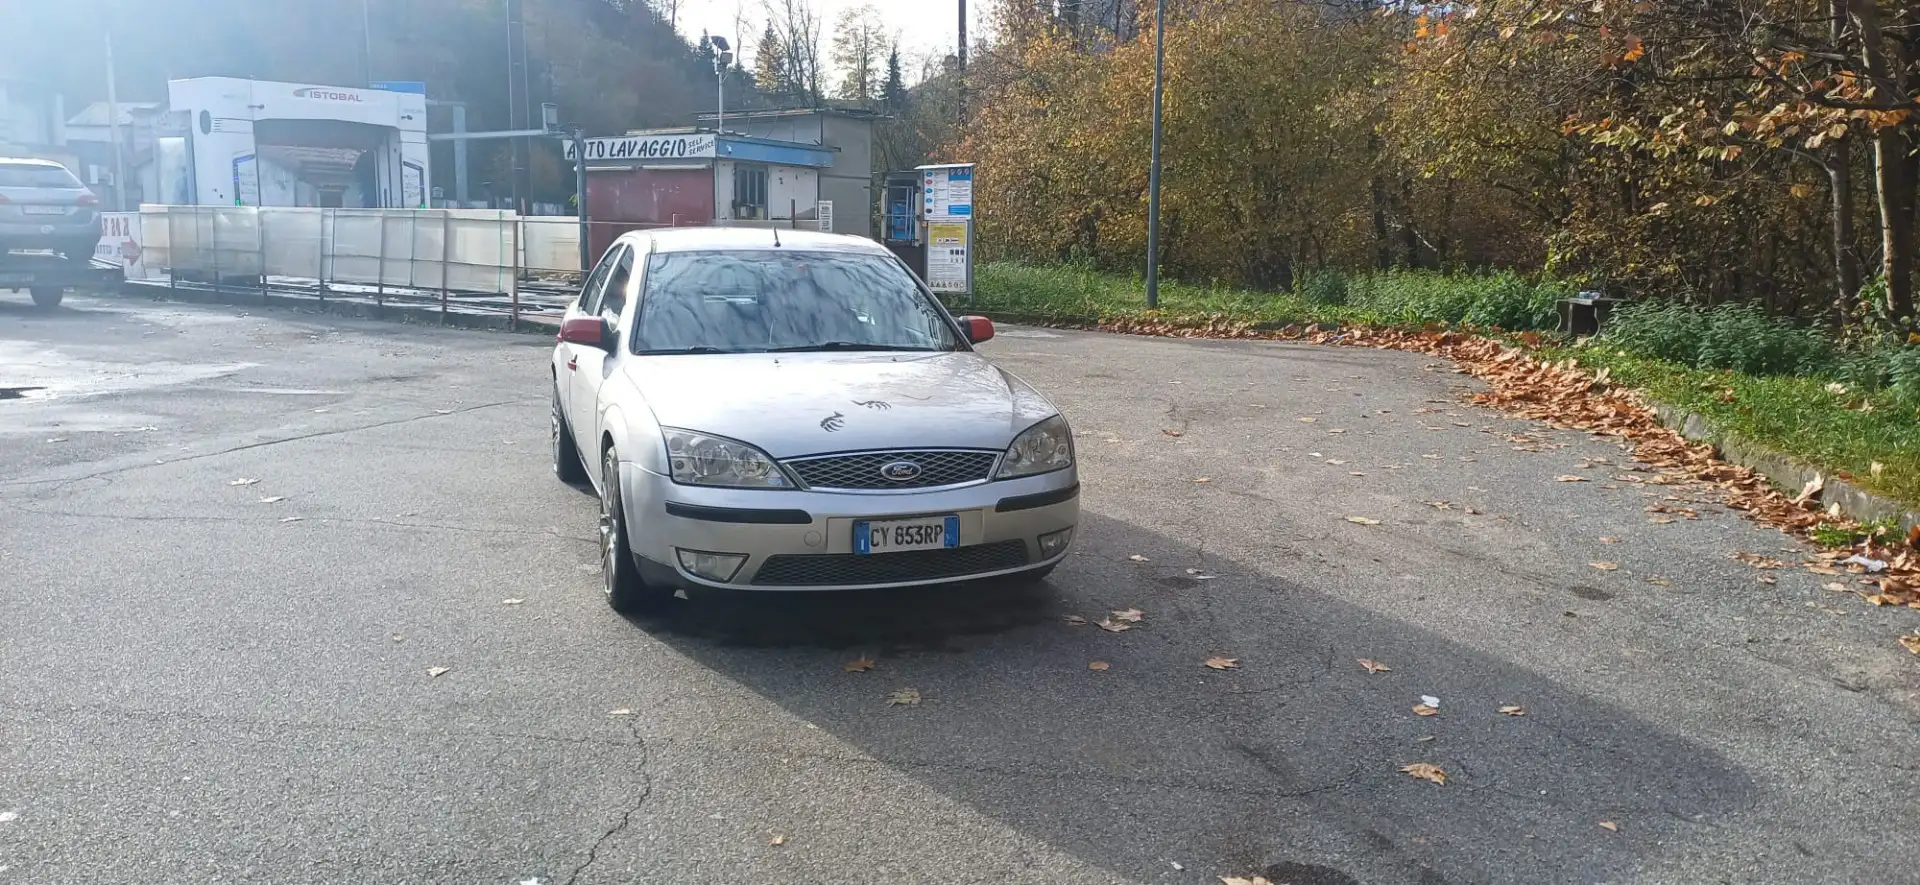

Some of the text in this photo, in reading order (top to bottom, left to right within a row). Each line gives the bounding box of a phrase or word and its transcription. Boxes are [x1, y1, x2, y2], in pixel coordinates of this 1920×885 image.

[310, 91, 363, 102] ISTOBAL
[567, 138, 686, 159] ATO LAVAGGIO
[688, 136, 703, 148] SELF
[688, 140, 715, 155] SERVICE
[892, 464, 913, 476] Ford
[871, 524, 943, 548] CY 853RP
